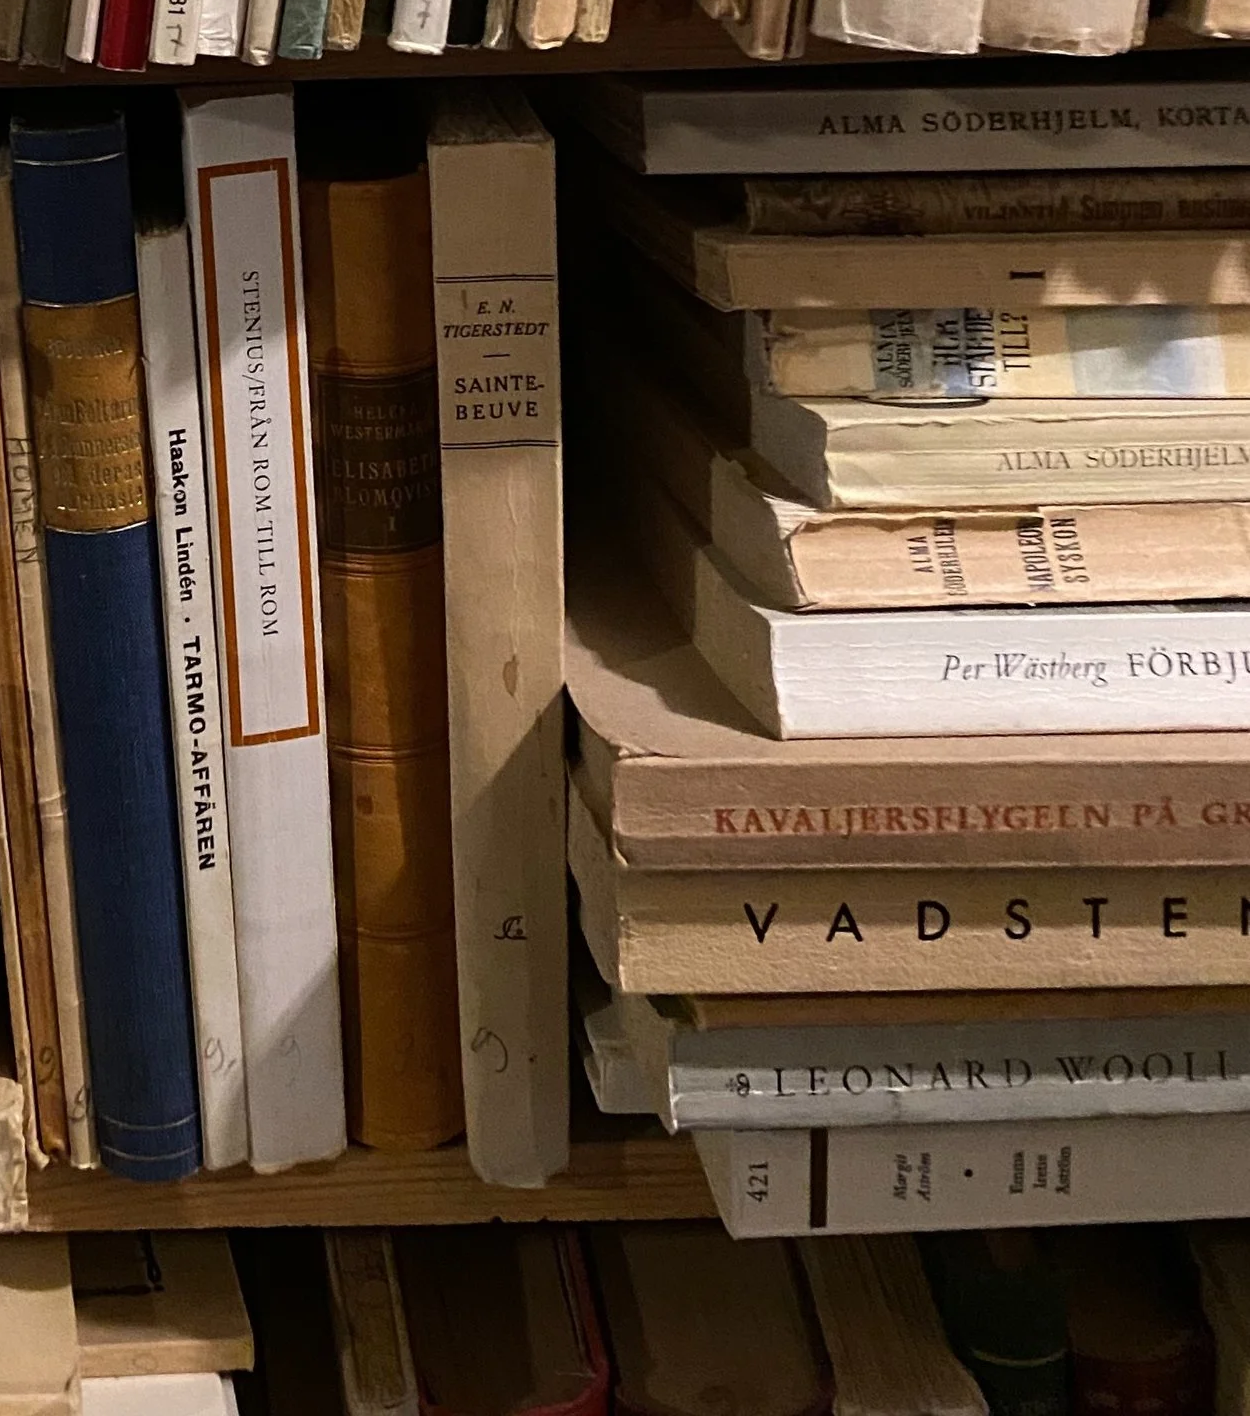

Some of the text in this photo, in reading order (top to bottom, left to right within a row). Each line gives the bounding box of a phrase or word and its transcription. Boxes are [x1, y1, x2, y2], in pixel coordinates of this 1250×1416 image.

[818, 105, 1250, 137] ALMA SÖDERHJELM, KORTA
[476, 298, 516, 315] E. N.
[442, 322, 550, 339] TIGERSTEDT
[1000, 312, 1032, 373] TILL?
[454, 375, 545, 394] SAINTE-
[455, 401, 539, 421] BEUVE
[241, 270, 279, 638] STENIUS/FRÅN ROM TILL ROM
[997, 449, 1071, 472] ALMA
[906, 535, 935, 574] ALMA
[1050, 517, 1091, 584] SYSKON
[167, 427, 217, 871] Haakon Lindén TARMO-AFFÄREN
[940, 654, 986, 682] Per
[994, 651, 1109, 687] Wästberg
[712, 804, 1111, 838] KAVALJERSFLYGELN
[1132, 796, 1178, 826] PÅ
[772, 1056, 1034, 1098] LEONARD
[746, 1162, 769, 1203] 421
[1009, 1150, 1025, 1196] Emma
